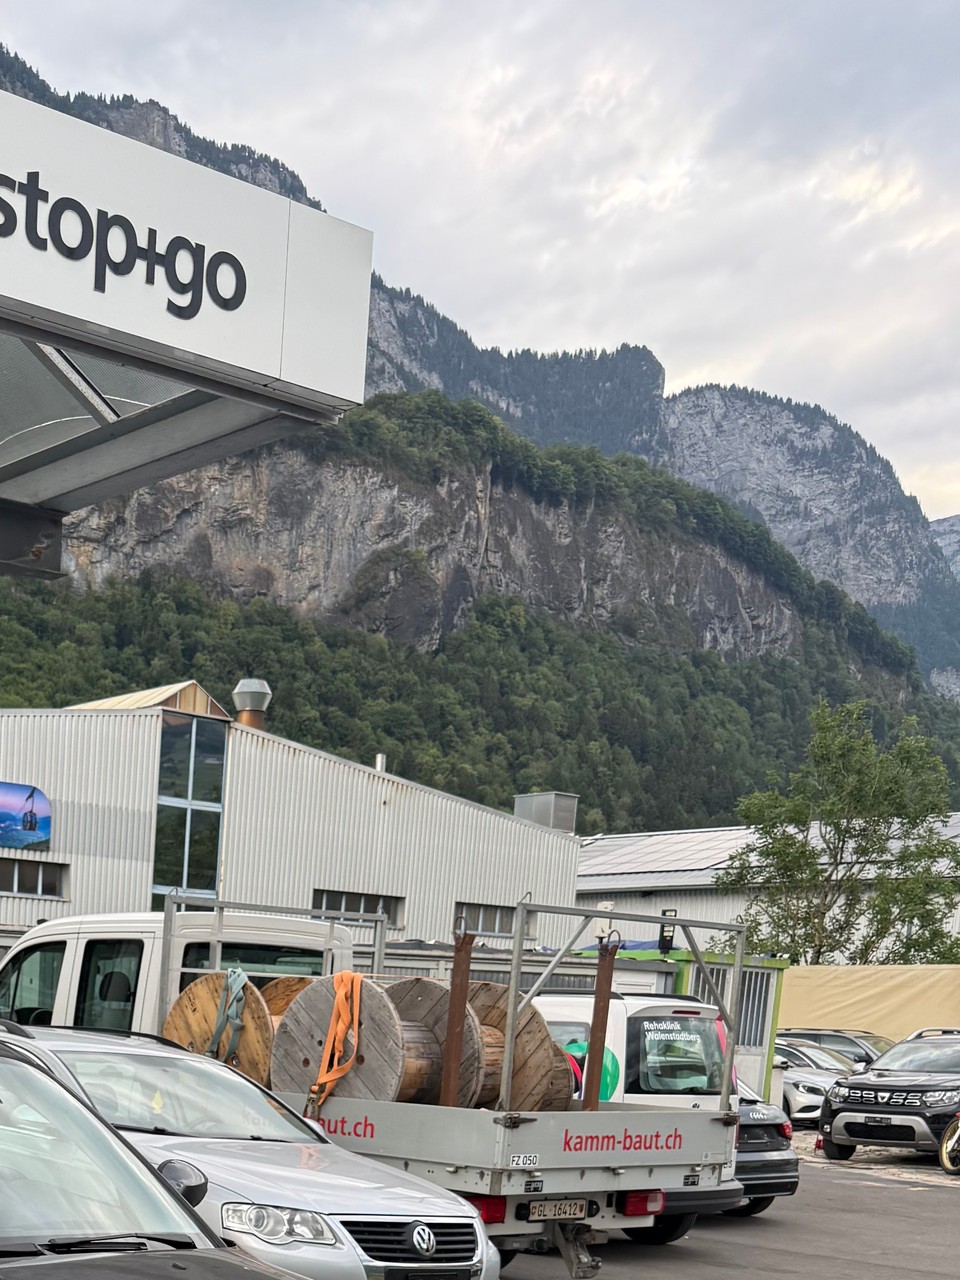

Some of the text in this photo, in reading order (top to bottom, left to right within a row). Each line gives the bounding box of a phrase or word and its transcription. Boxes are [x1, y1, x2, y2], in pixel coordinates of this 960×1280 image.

[643, 1021, 682, 1030] Rehaklinik
[645, 1031, 701, 1044] Walenstadtberg
[562, 1128, 683, 1152] kamm-baut.ch
[511, 1155, 538, 1166] FZ 050
